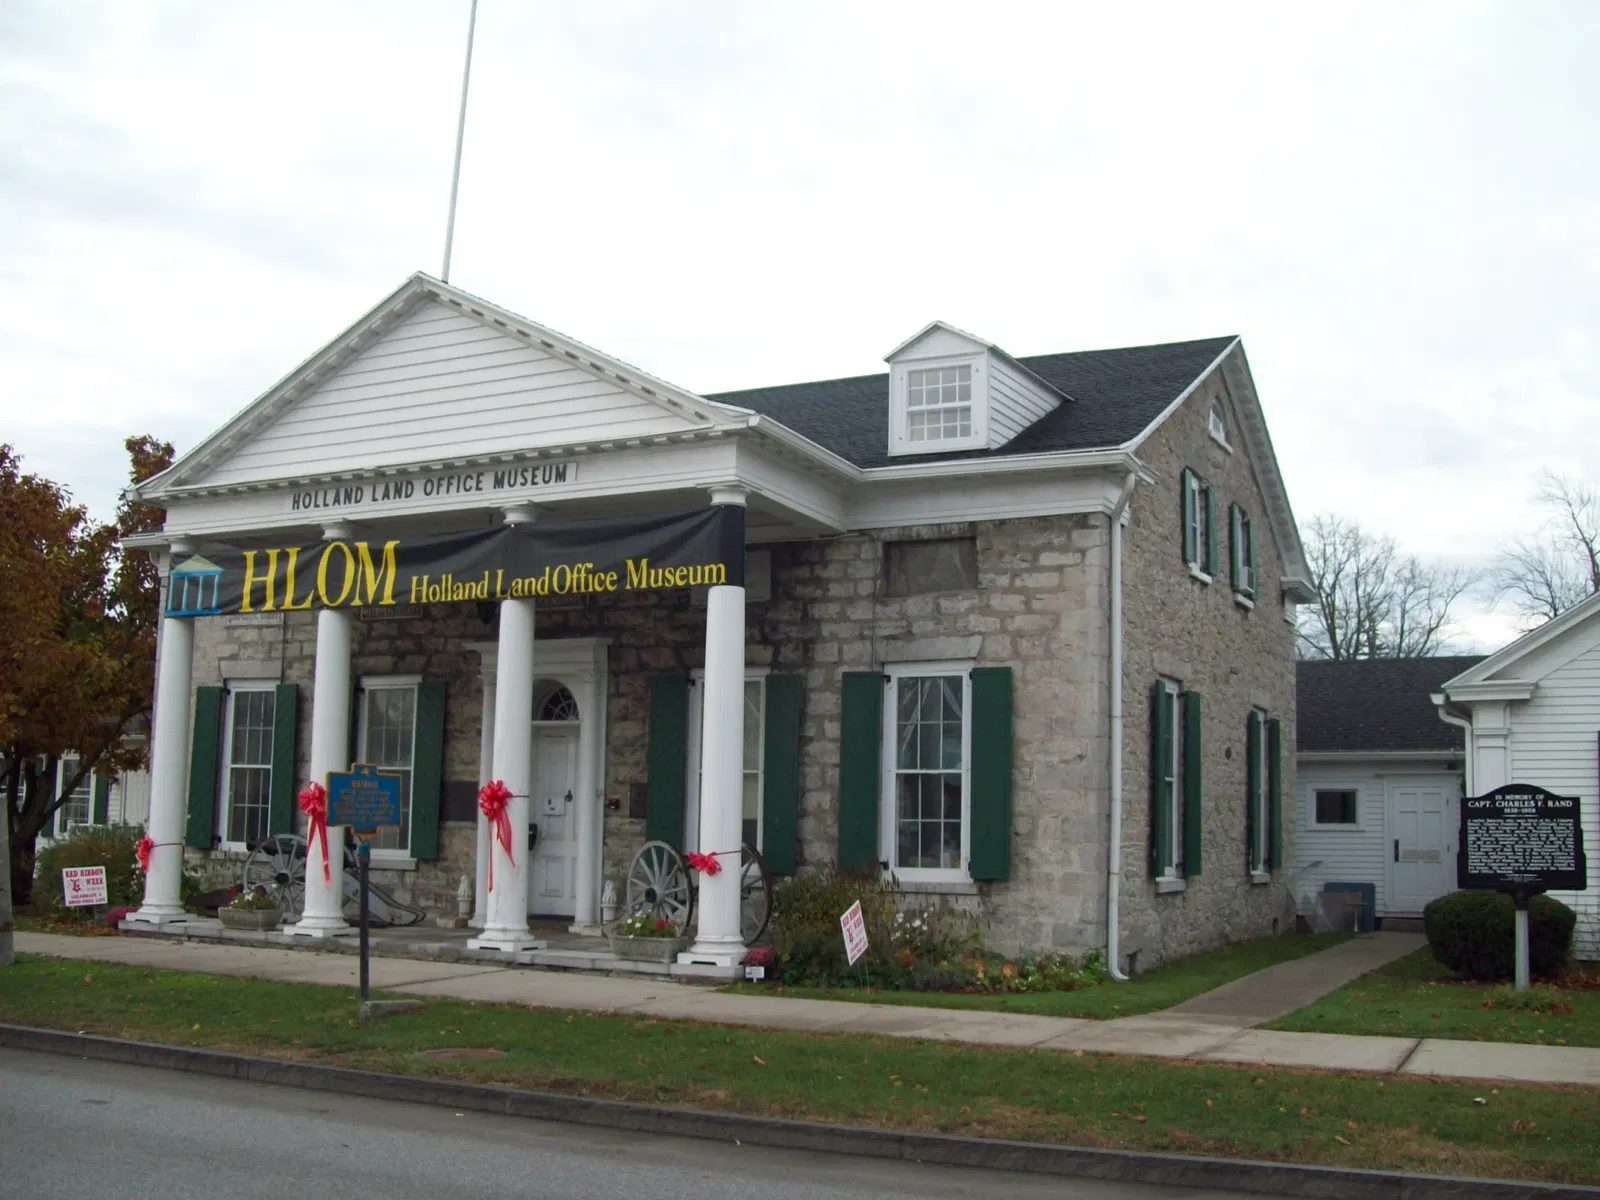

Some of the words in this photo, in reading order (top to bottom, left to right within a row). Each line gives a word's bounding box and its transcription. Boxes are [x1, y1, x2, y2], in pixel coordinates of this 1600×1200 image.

[292, 487, 364, 510] HOLLAND
[372, 480, 414, 502] LAND
[423, 472, 485, 496] OFFICE
[493, 463, 567, 489] MUSEUM
[239, 540, 400, 613] HLOM
[409, 572, 489, 604] Holland
[496, 566, 550, 598] Land
[552, 562, 618, 594] Office
[625, 558, 726, 590] Museum
[1496, 800, 1536, 808] CHARLES
[1547, 800, 1573, 808] RAND
